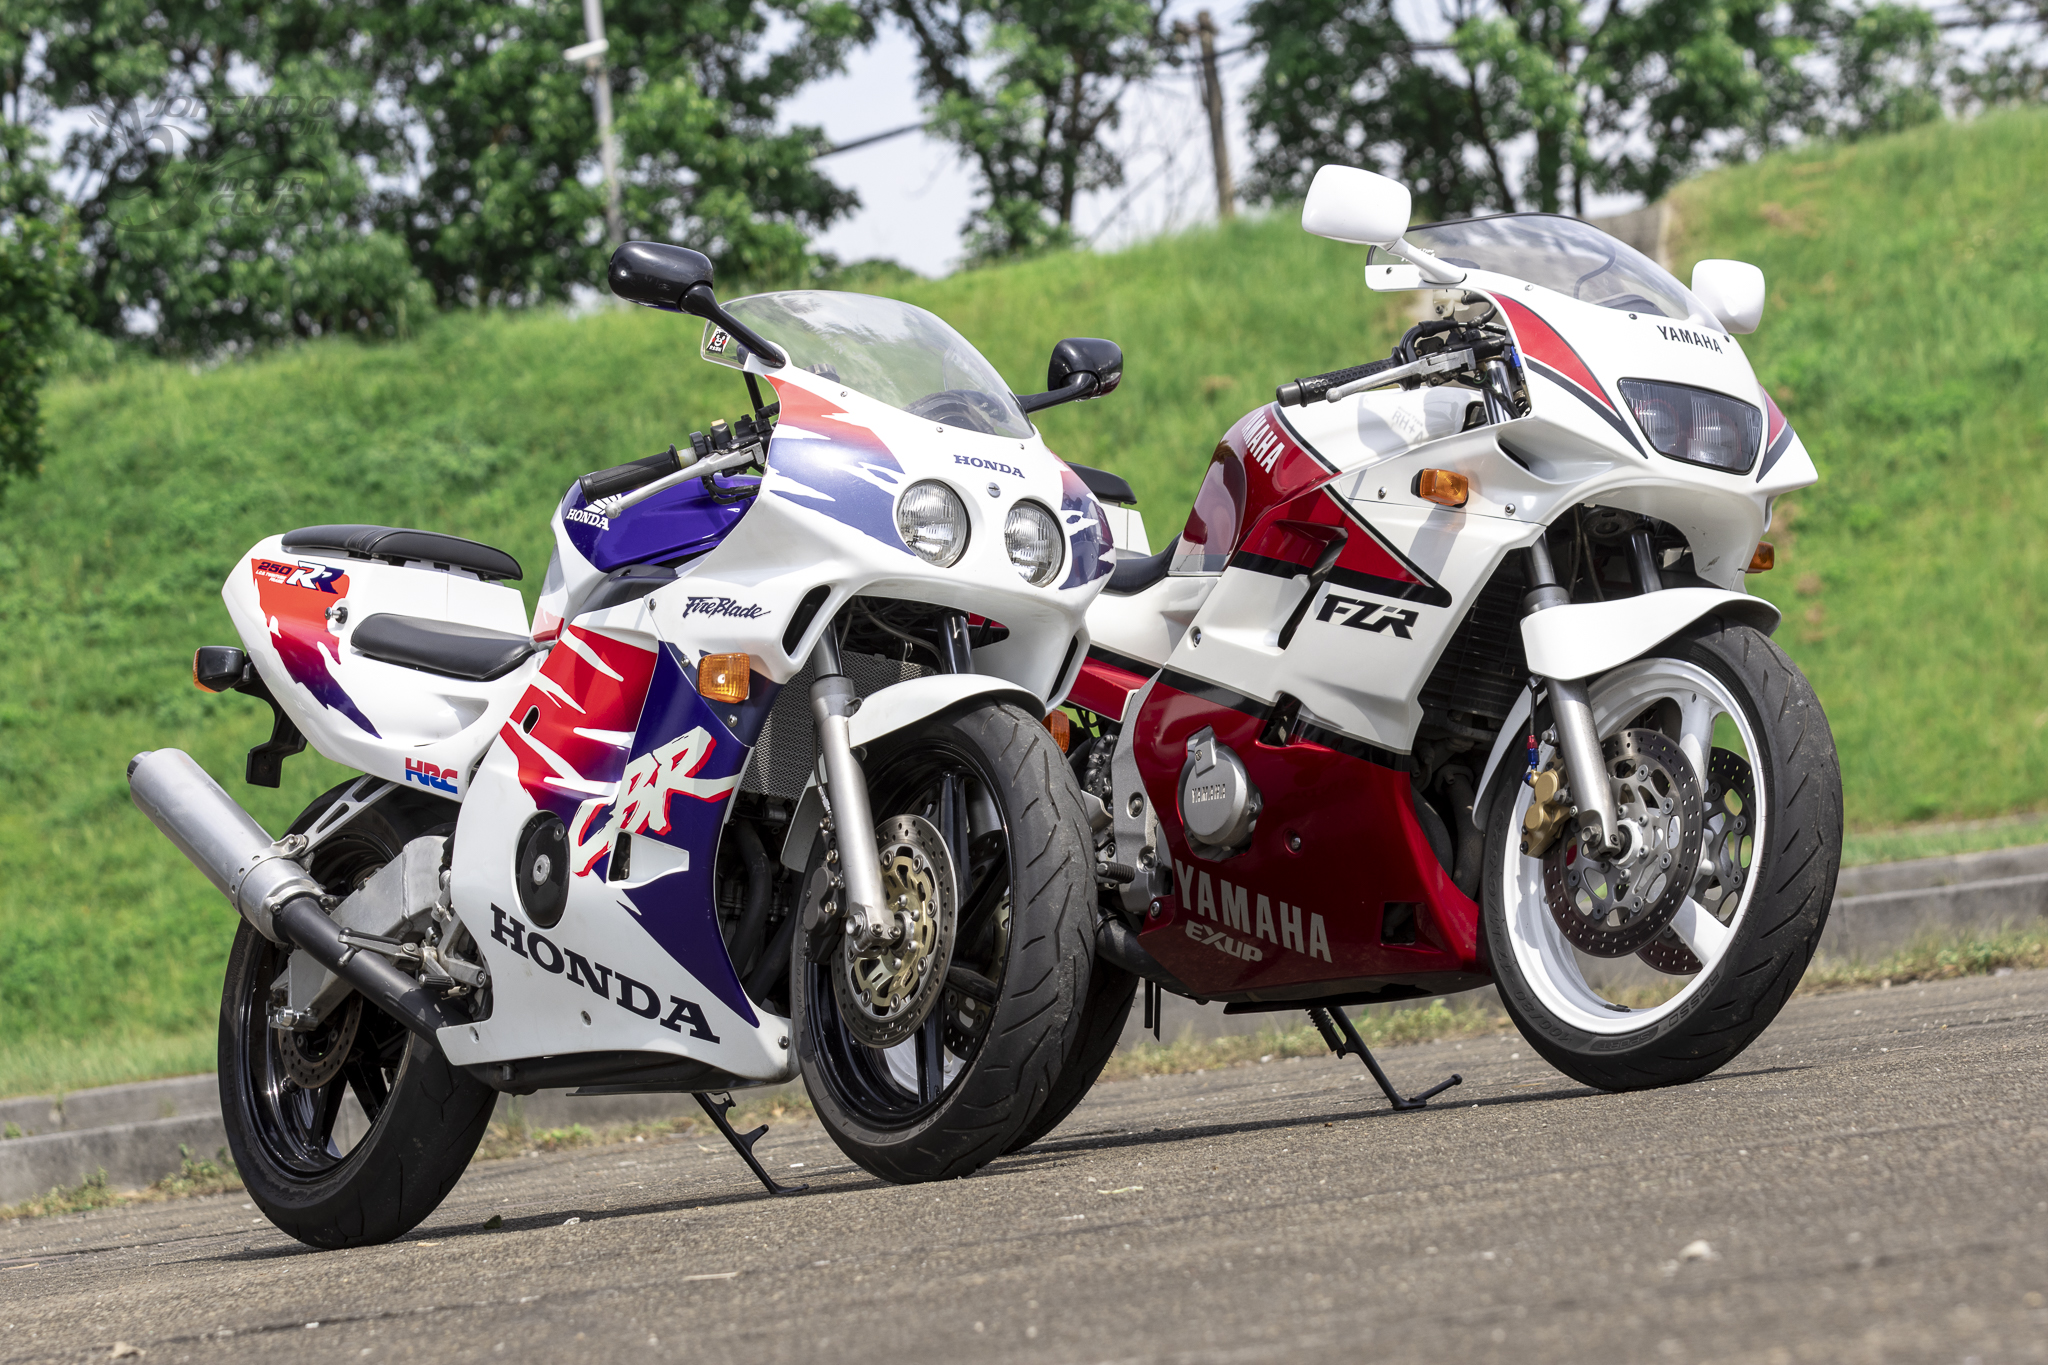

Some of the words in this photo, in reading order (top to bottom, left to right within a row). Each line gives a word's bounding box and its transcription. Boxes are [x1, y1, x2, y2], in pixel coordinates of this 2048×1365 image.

[1656, 324, 1723, 355] YAMAHA
[954, 454, 1025, 479] HONDA
[565, 508, 610, 531] HONDA
[257, 561, 293, 575] 250
[286, 559, 345, 594] RR
[1315, 593, 1420, 641] FZR
[405, 757, 458, 795] HRC
[1191, 783, 1227, 804] YAMAHA
[570, 725, 741, 877] CBR
[1174, 858, 1333, 964] YAMAHA
[1185, 919, 1264, 963] EXUP
[490, 902, 720, 1044] HONDA
[1667, 970, 1721, 1028] ROSSO
[1598, 1031, 1651, 1050] SPORT
